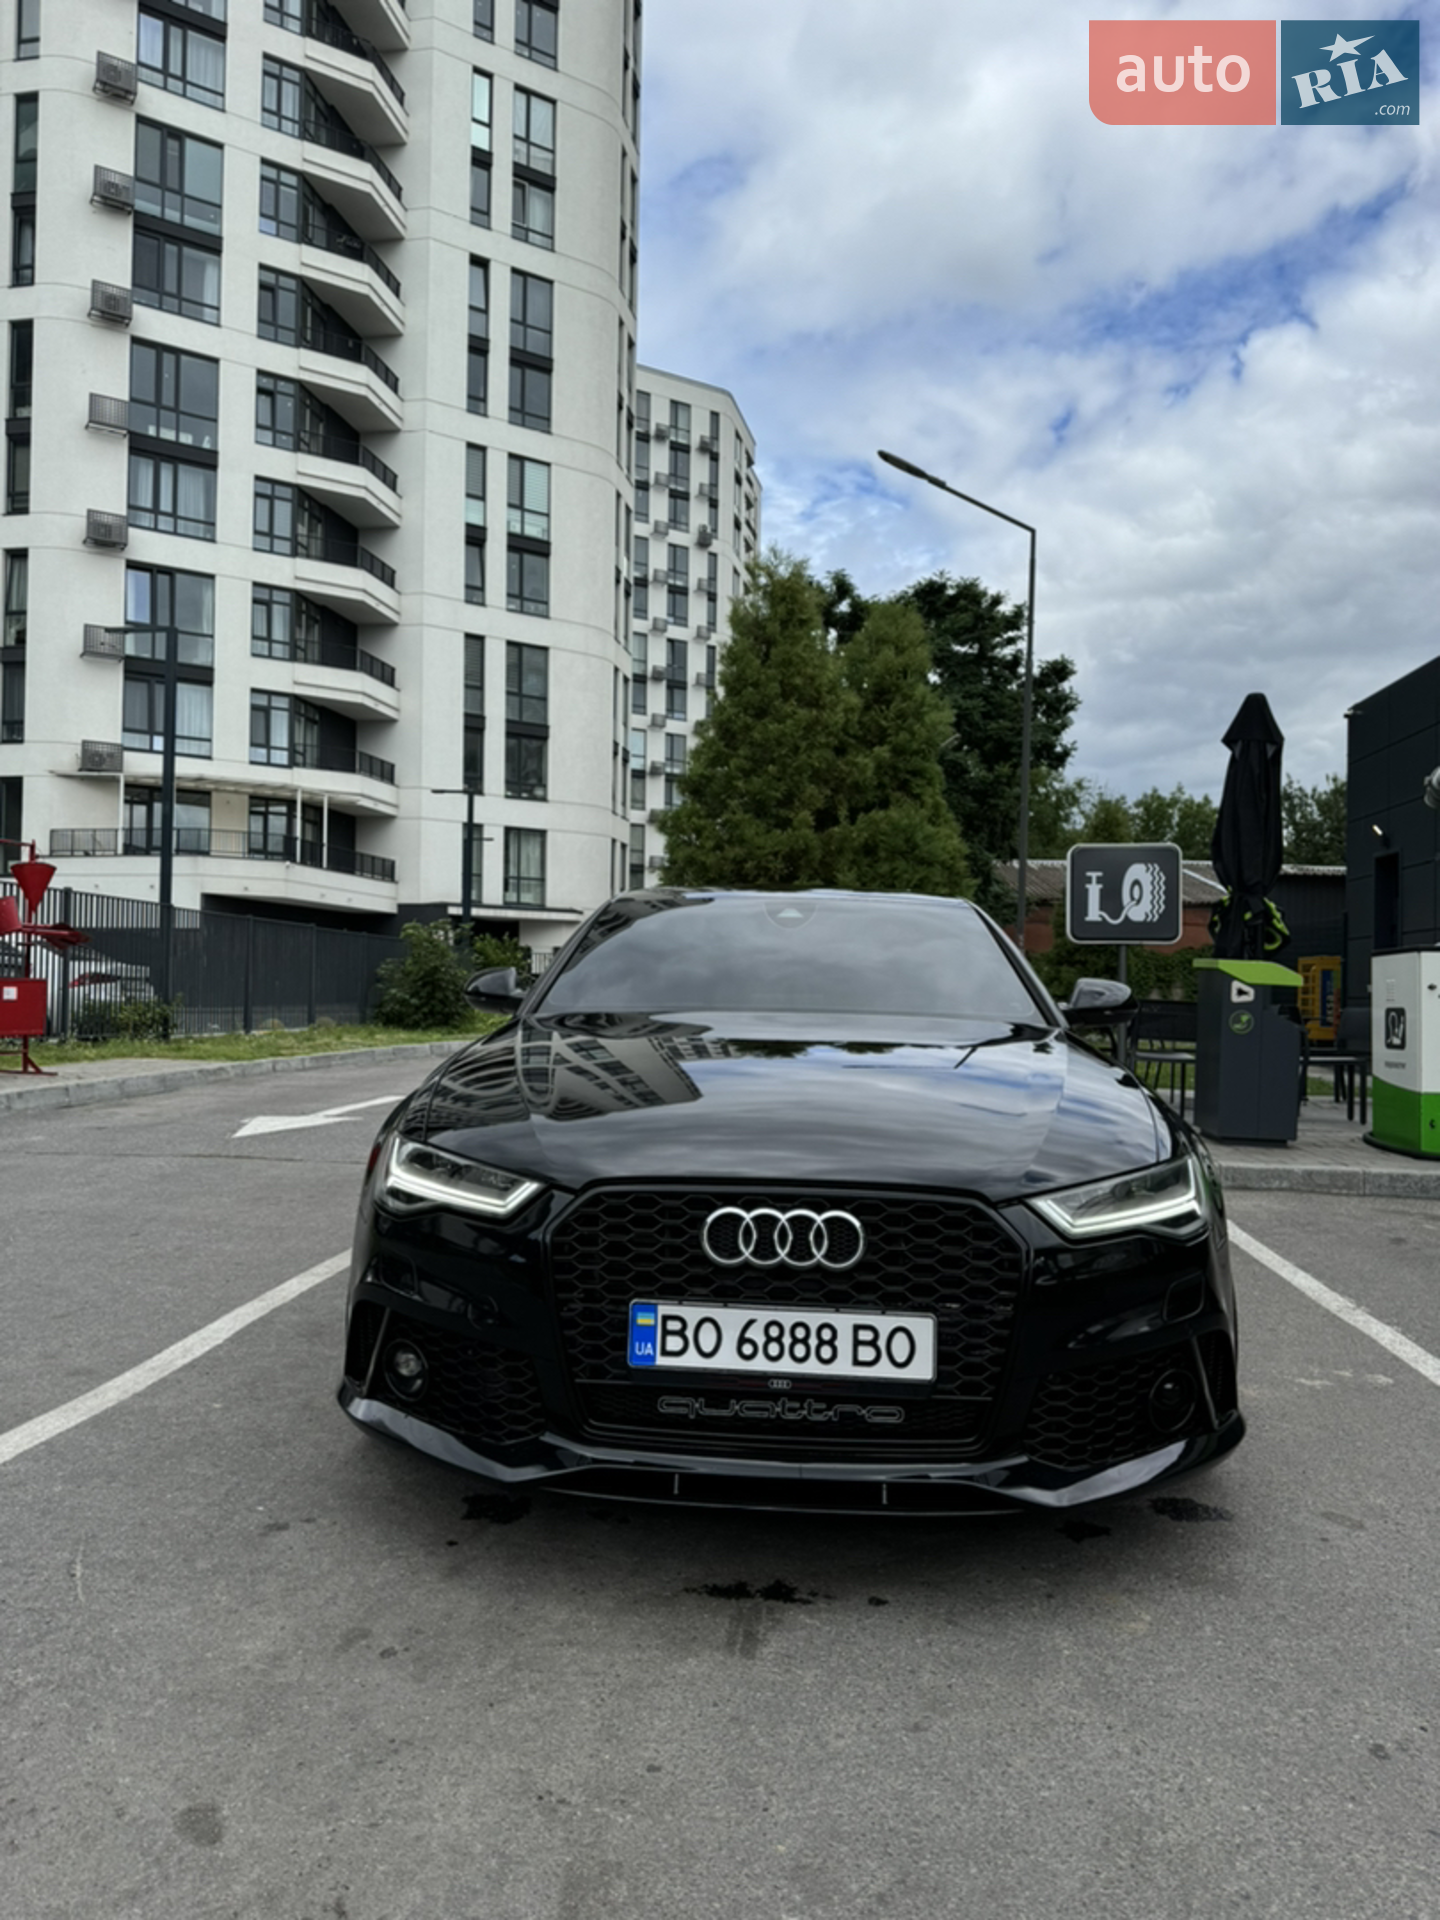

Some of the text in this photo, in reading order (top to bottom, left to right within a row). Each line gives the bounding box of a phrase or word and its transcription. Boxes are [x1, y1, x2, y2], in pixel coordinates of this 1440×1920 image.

[634, 1342, 654, 1357] UA
[659, 1314, 916, 1369] BO 6888 BO
[657, 1395, 905, 1423] quattro
